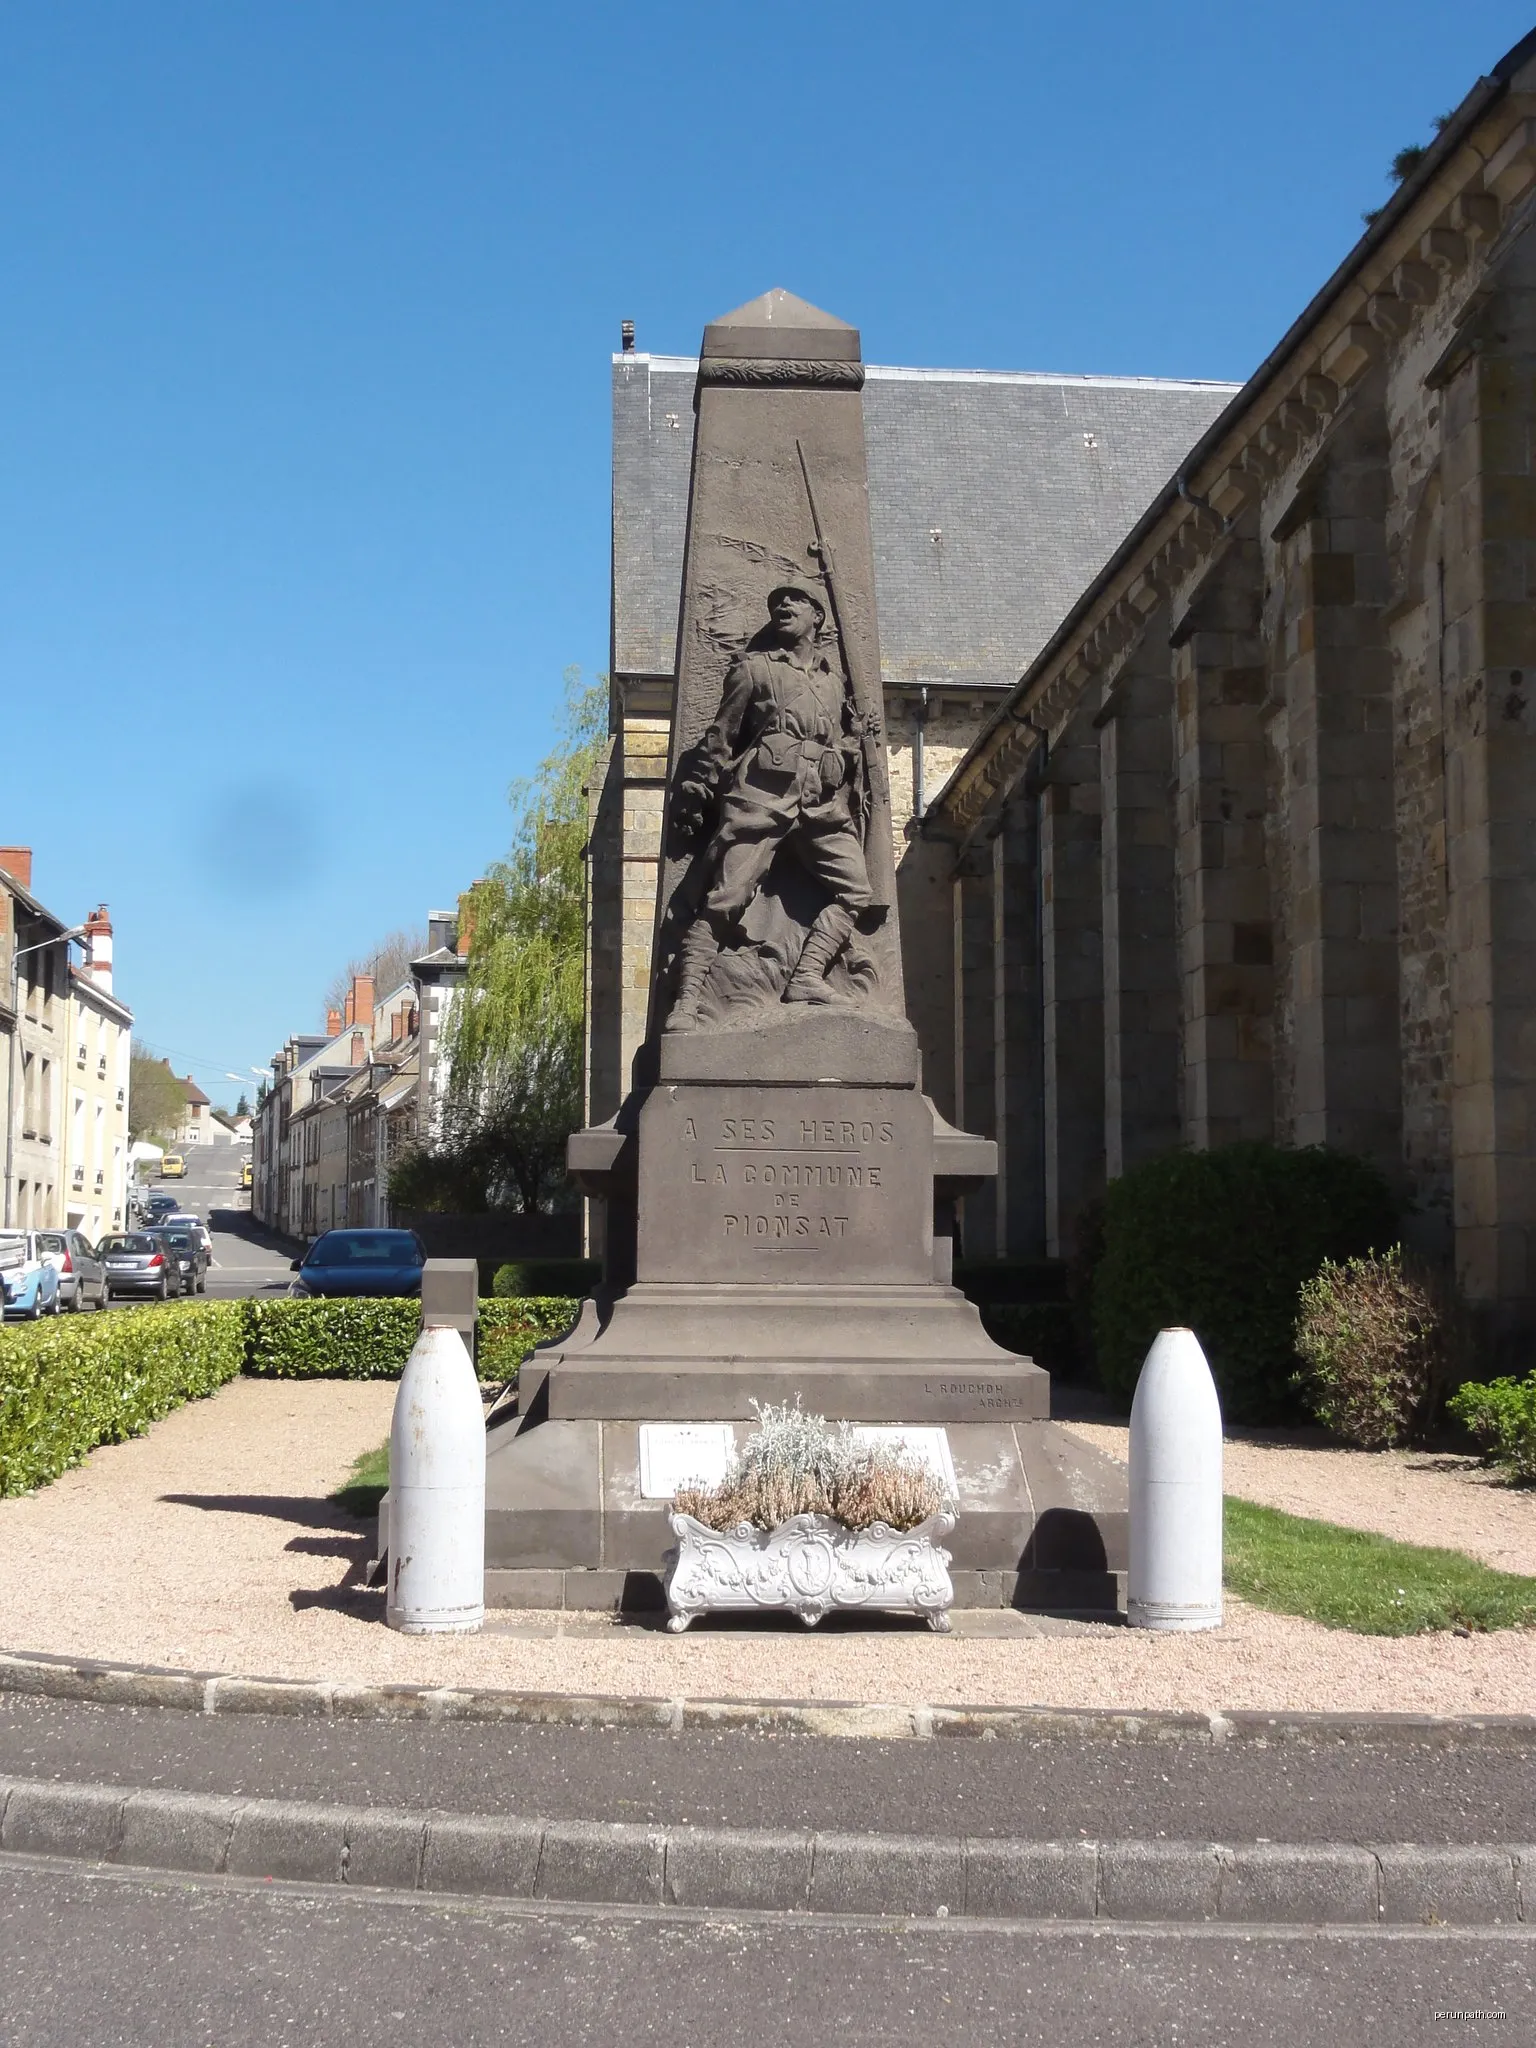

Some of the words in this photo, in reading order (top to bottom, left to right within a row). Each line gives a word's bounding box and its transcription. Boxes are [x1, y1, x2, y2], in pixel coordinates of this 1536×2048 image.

[681, 1117, 698, 1142] A
[722, 1118, 776, 1142] SES
[799, 1119, 895, 1145] HEROS
[691, 1163, 729, 1185] LA
[743, 1164, 883, 1188] COMMUNE
[773, 1193, 801, 1208] DE
[723, 1214, 850, 1237] PIONSAT
